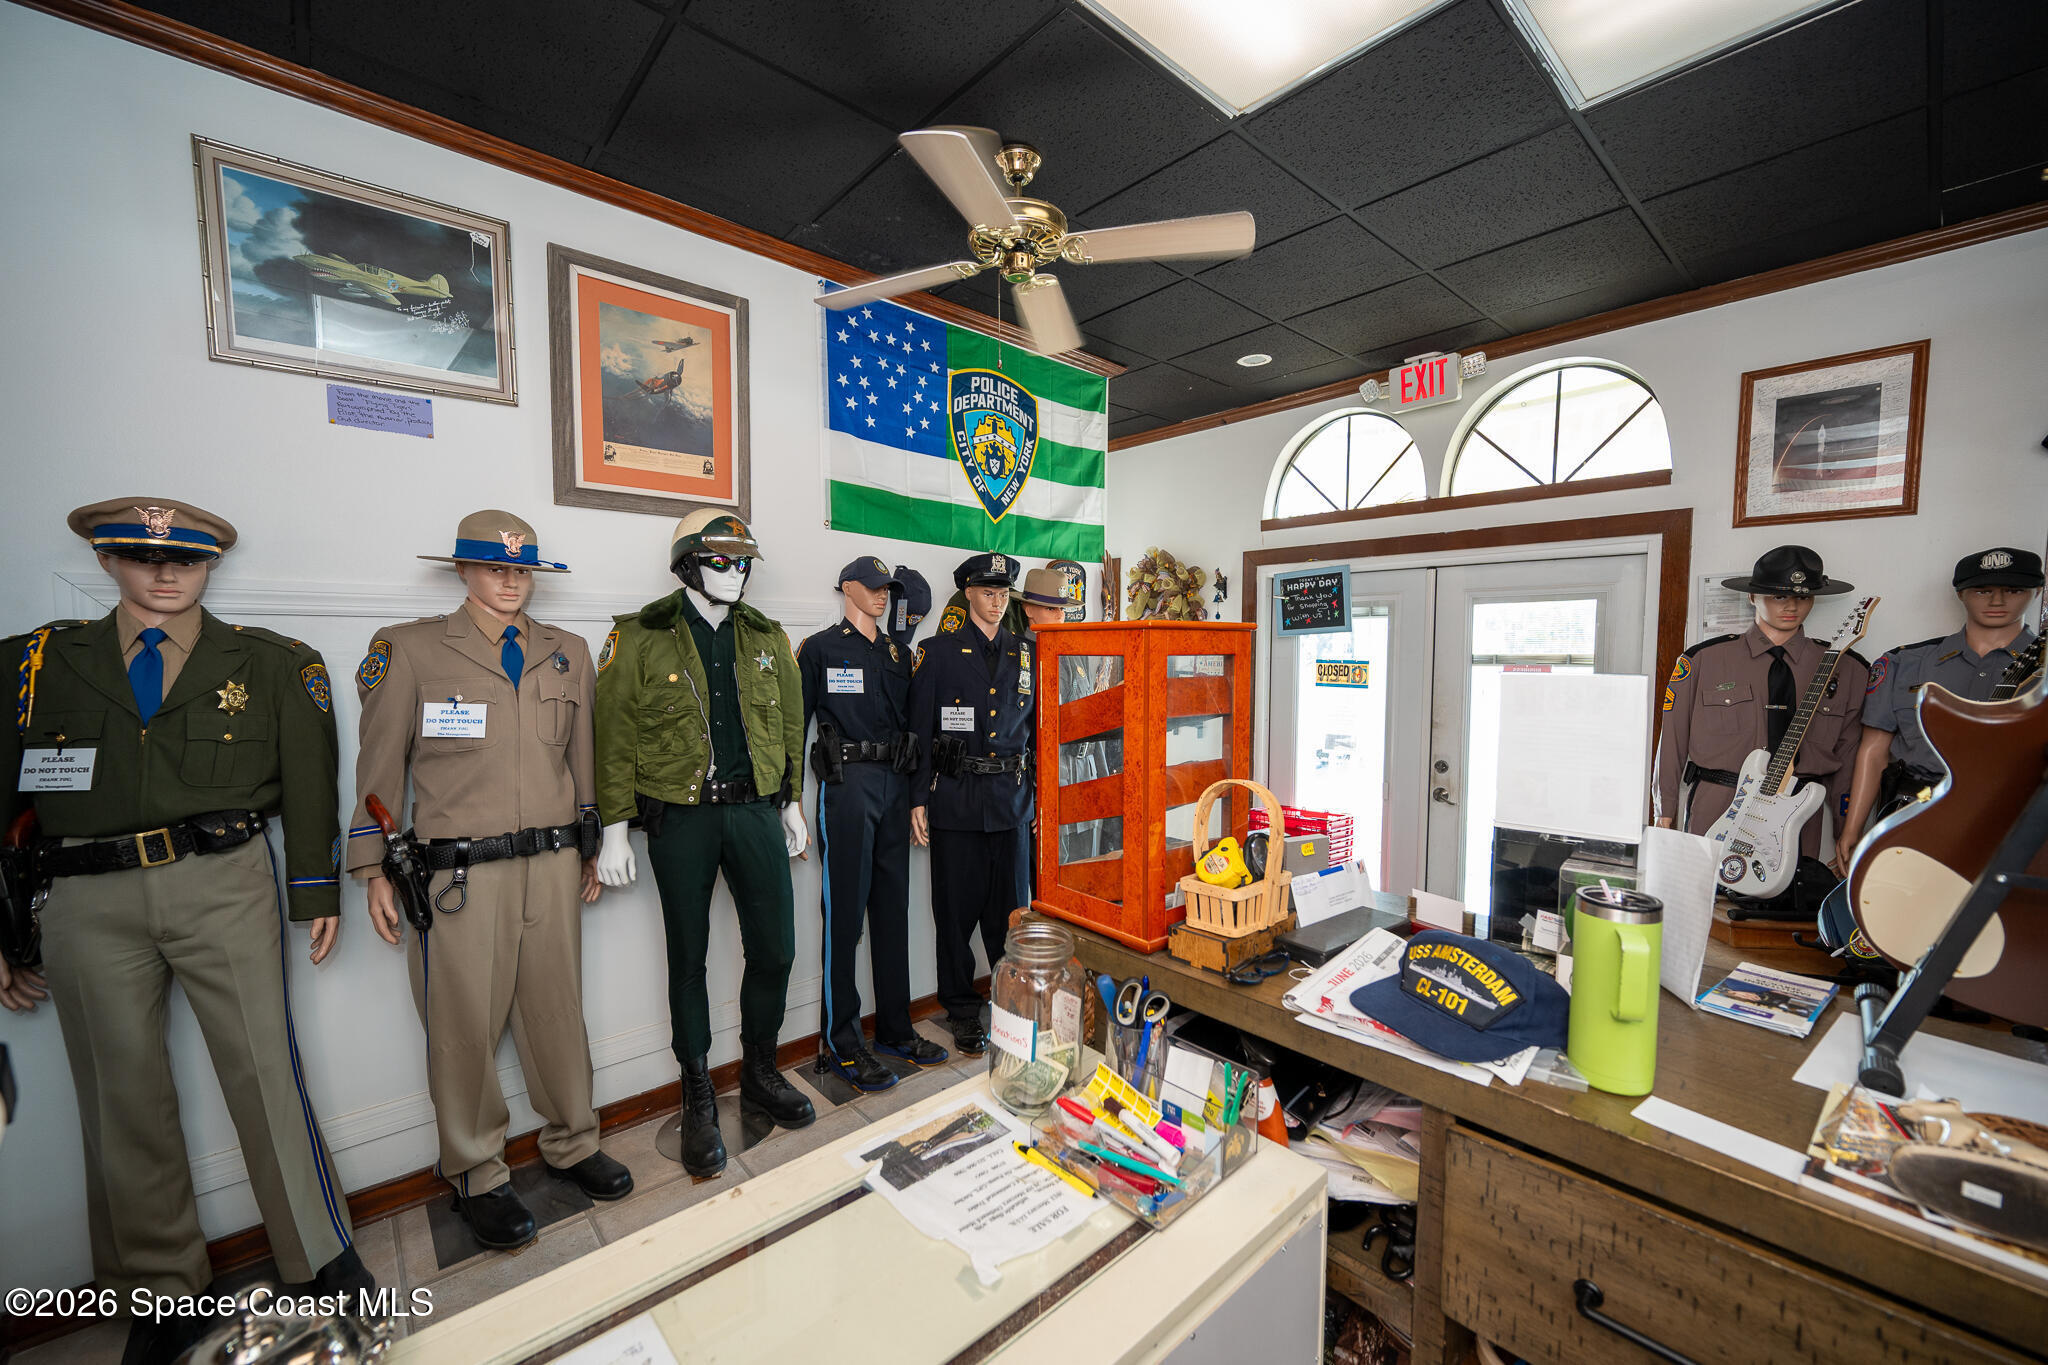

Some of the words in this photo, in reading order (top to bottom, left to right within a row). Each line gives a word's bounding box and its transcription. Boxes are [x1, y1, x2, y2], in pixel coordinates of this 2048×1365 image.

[971, 376, 1019, 405] POLICE
[1400, 358, 1448, 404] EXIT
[954, 393, 1034, 432] DEPARTMENT
[956, 430, 975, 468] CITY
[972, 475, 987, 493] OF
[1000, 477, 1020, 506] NEW
[1017, 437, 1035, 474] YORK
[1287, 581, 1316, 591] HAPPY
[1318, 578, 1338, 588] DAY
[1290, 593, 1314, 601] Thank
[1317, 664, 1350, 677] CLOSED
[1725, 774, 1754, 820] NAVY
[1327, 967, 1355, 987] JUNE
[1349, 951, 1374, 971] 2026
[1409, 944, 1433, 960] USS
[1431, 944, 1518, 1007] AMSTERDAM
[1415, 977, 1469, 1016] CL-101
[1029, 1215, 1053, 1233] SALE
[1052, 1206, 1069, 1221] FOR
